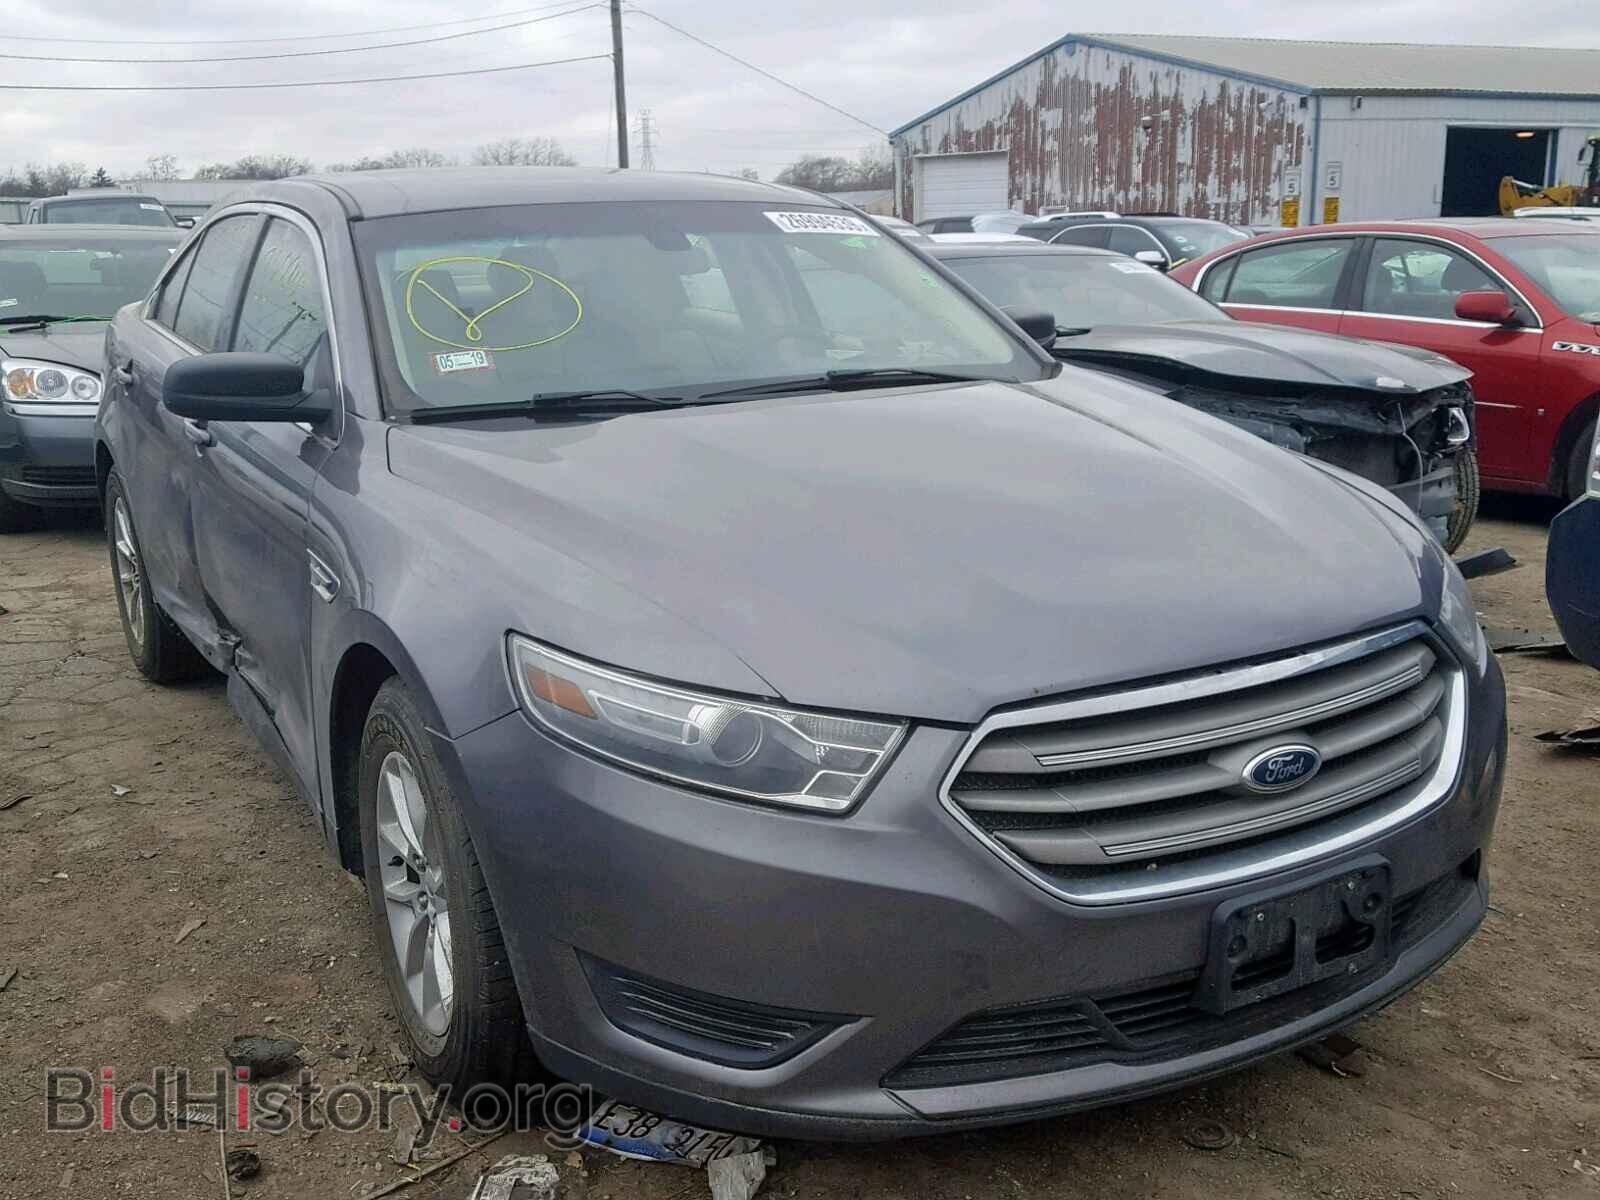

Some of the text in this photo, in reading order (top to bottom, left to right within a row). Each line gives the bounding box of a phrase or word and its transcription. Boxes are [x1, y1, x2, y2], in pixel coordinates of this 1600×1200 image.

[440, 355, 454, 369] 05
[470, 351, 484, 366] 19
[1265, 754, 1304, 782] Ford
